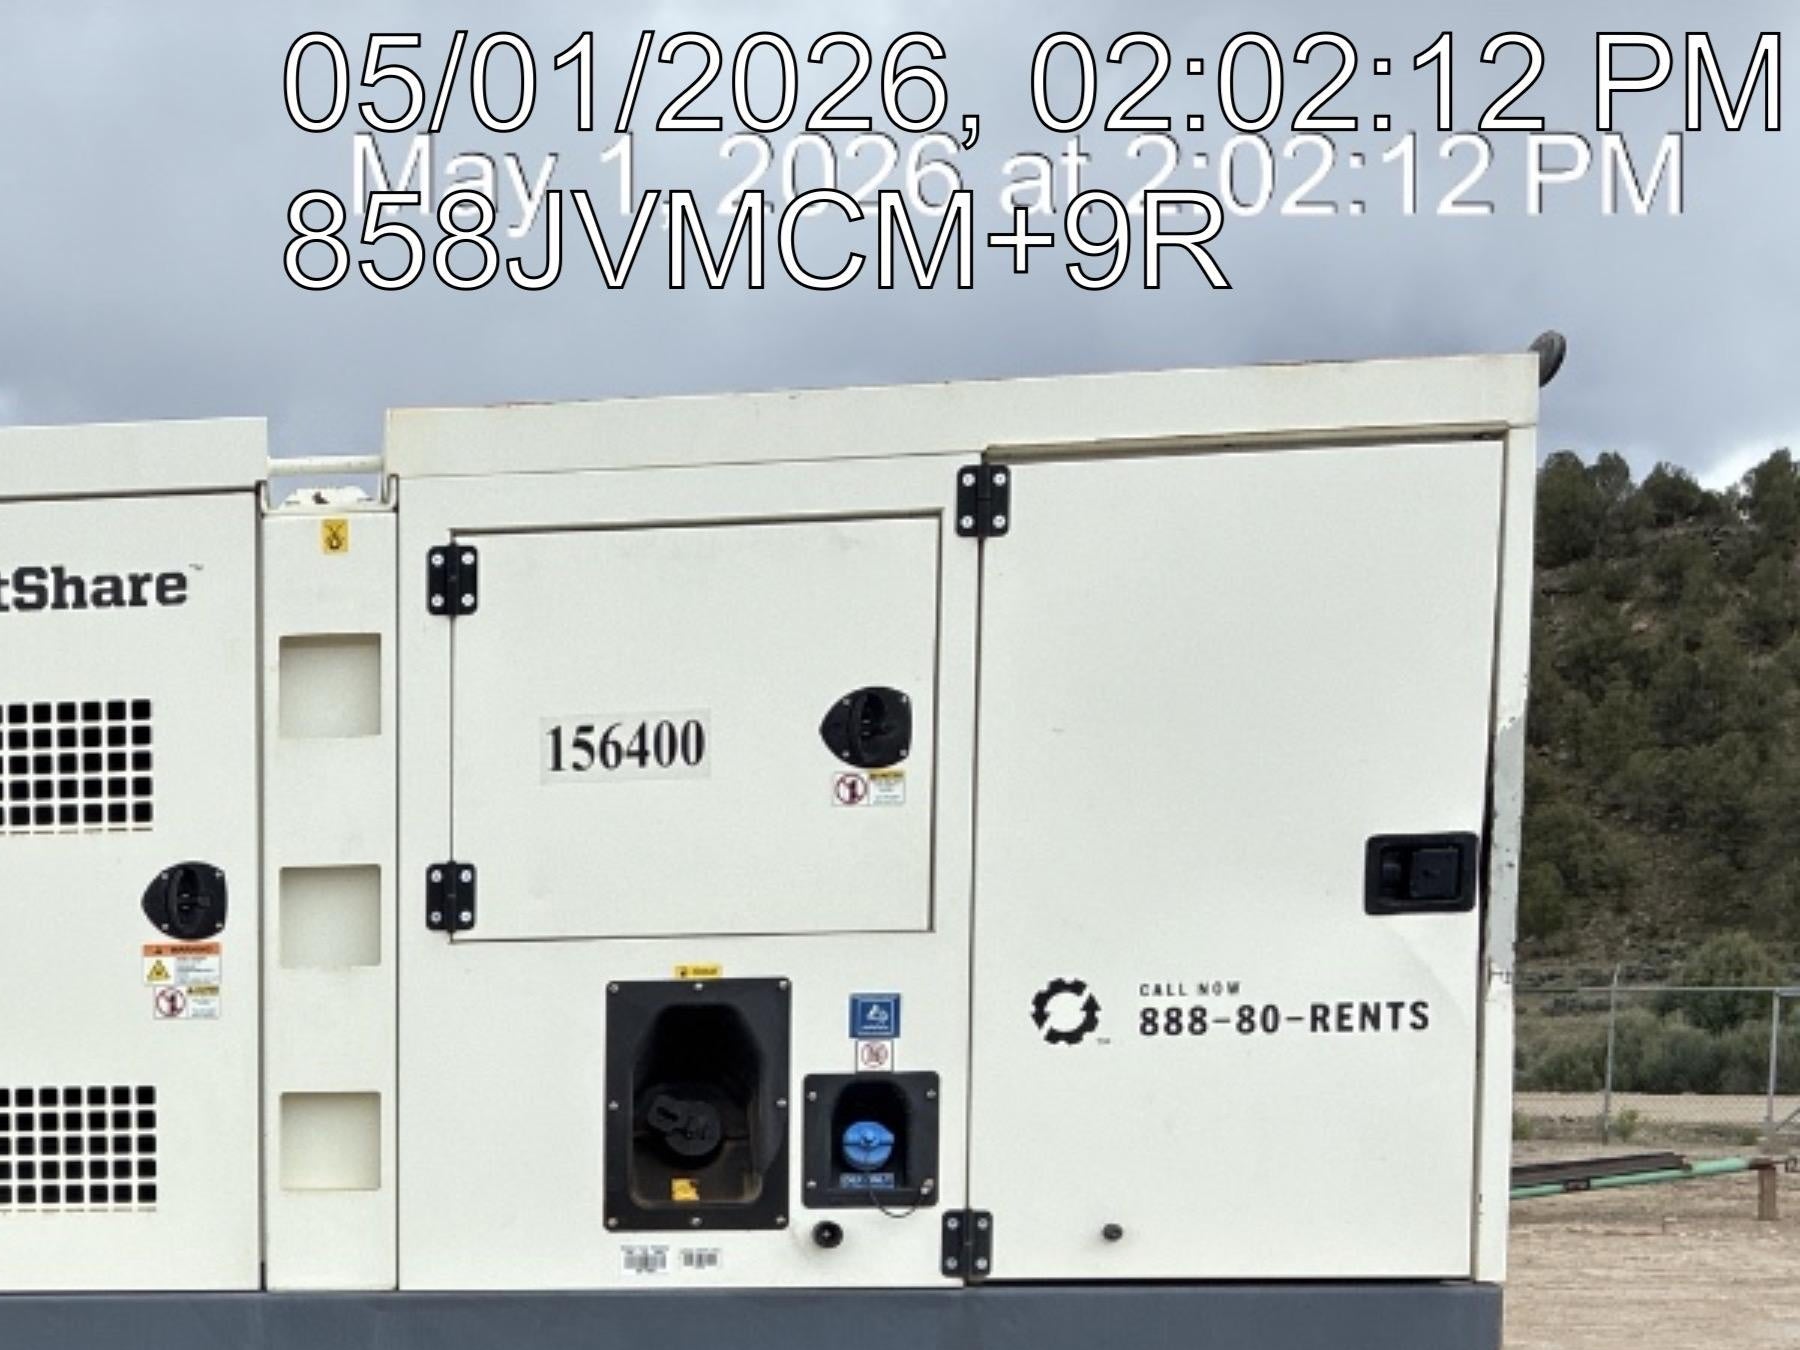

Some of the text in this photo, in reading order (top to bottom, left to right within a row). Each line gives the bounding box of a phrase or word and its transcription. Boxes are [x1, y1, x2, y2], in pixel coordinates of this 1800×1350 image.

[546, 718, 706, 772] 156400
[1139, 980, 1241, 997] CALL NOW
[1138, 1000, 1431, 1037] 888-80-RENTS
